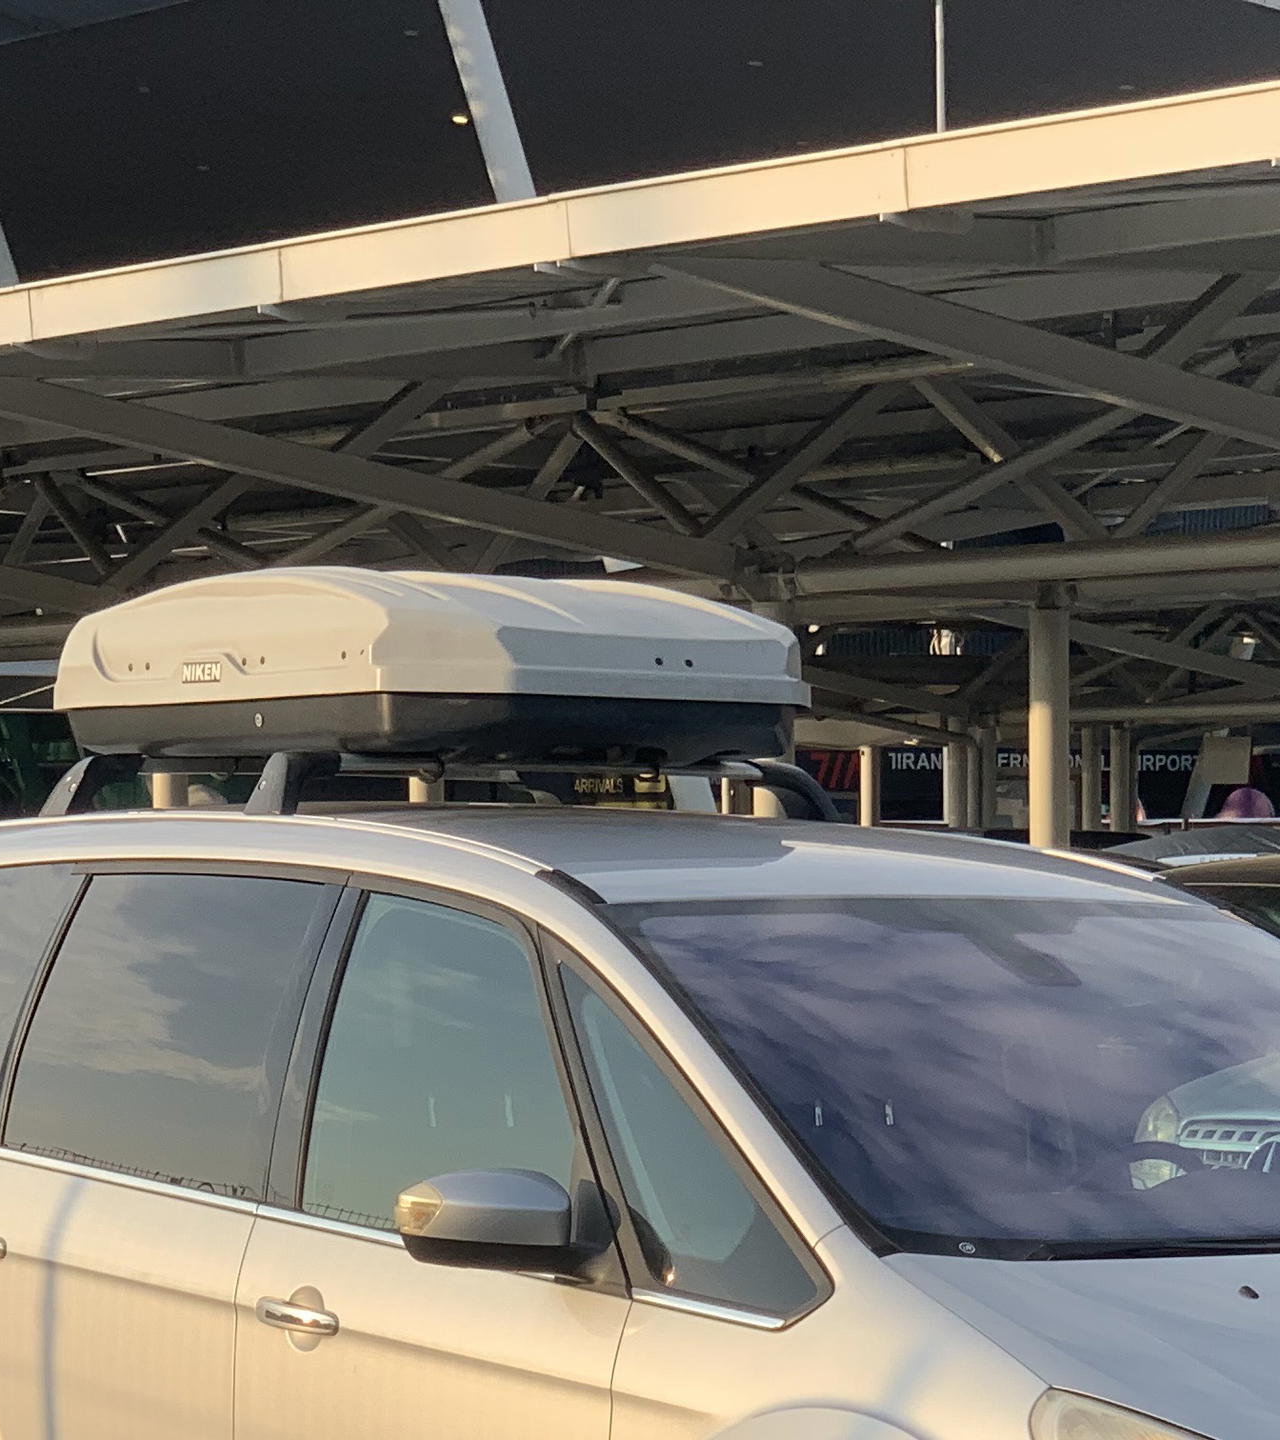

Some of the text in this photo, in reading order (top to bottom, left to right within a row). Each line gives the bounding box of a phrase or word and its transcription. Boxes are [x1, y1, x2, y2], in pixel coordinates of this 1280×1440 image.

[182, 663, 221, 682] NIKEN
[888, 752, 942, 770] TIRAN
[574, 777, 624, 793] ARRIVALS
